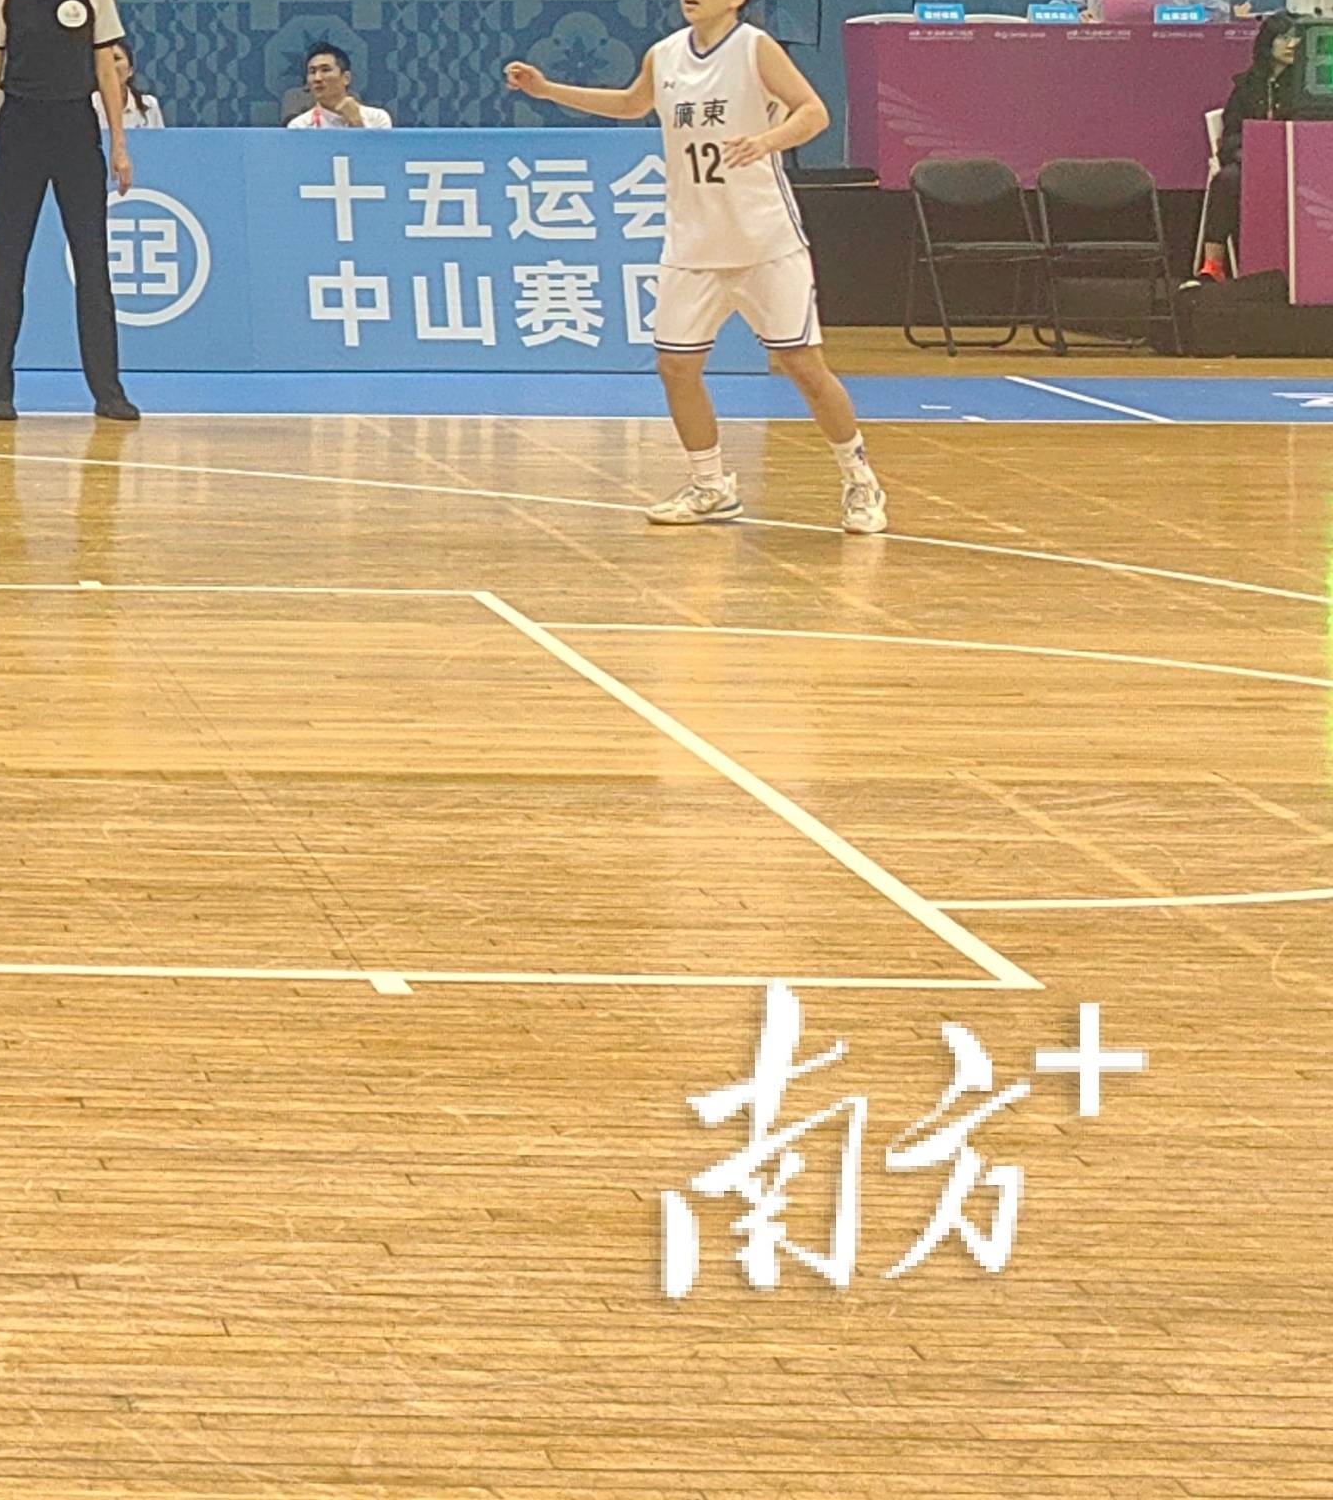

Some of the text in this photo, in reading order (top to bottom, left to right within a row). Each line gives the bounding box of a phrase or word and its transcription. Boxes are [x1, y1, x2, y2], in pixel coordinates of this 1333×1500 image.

[673, 98, 728, 129] 廣東
[684, 141, 726, 184] 12
[299, 155, 666, 242] 十五运会
